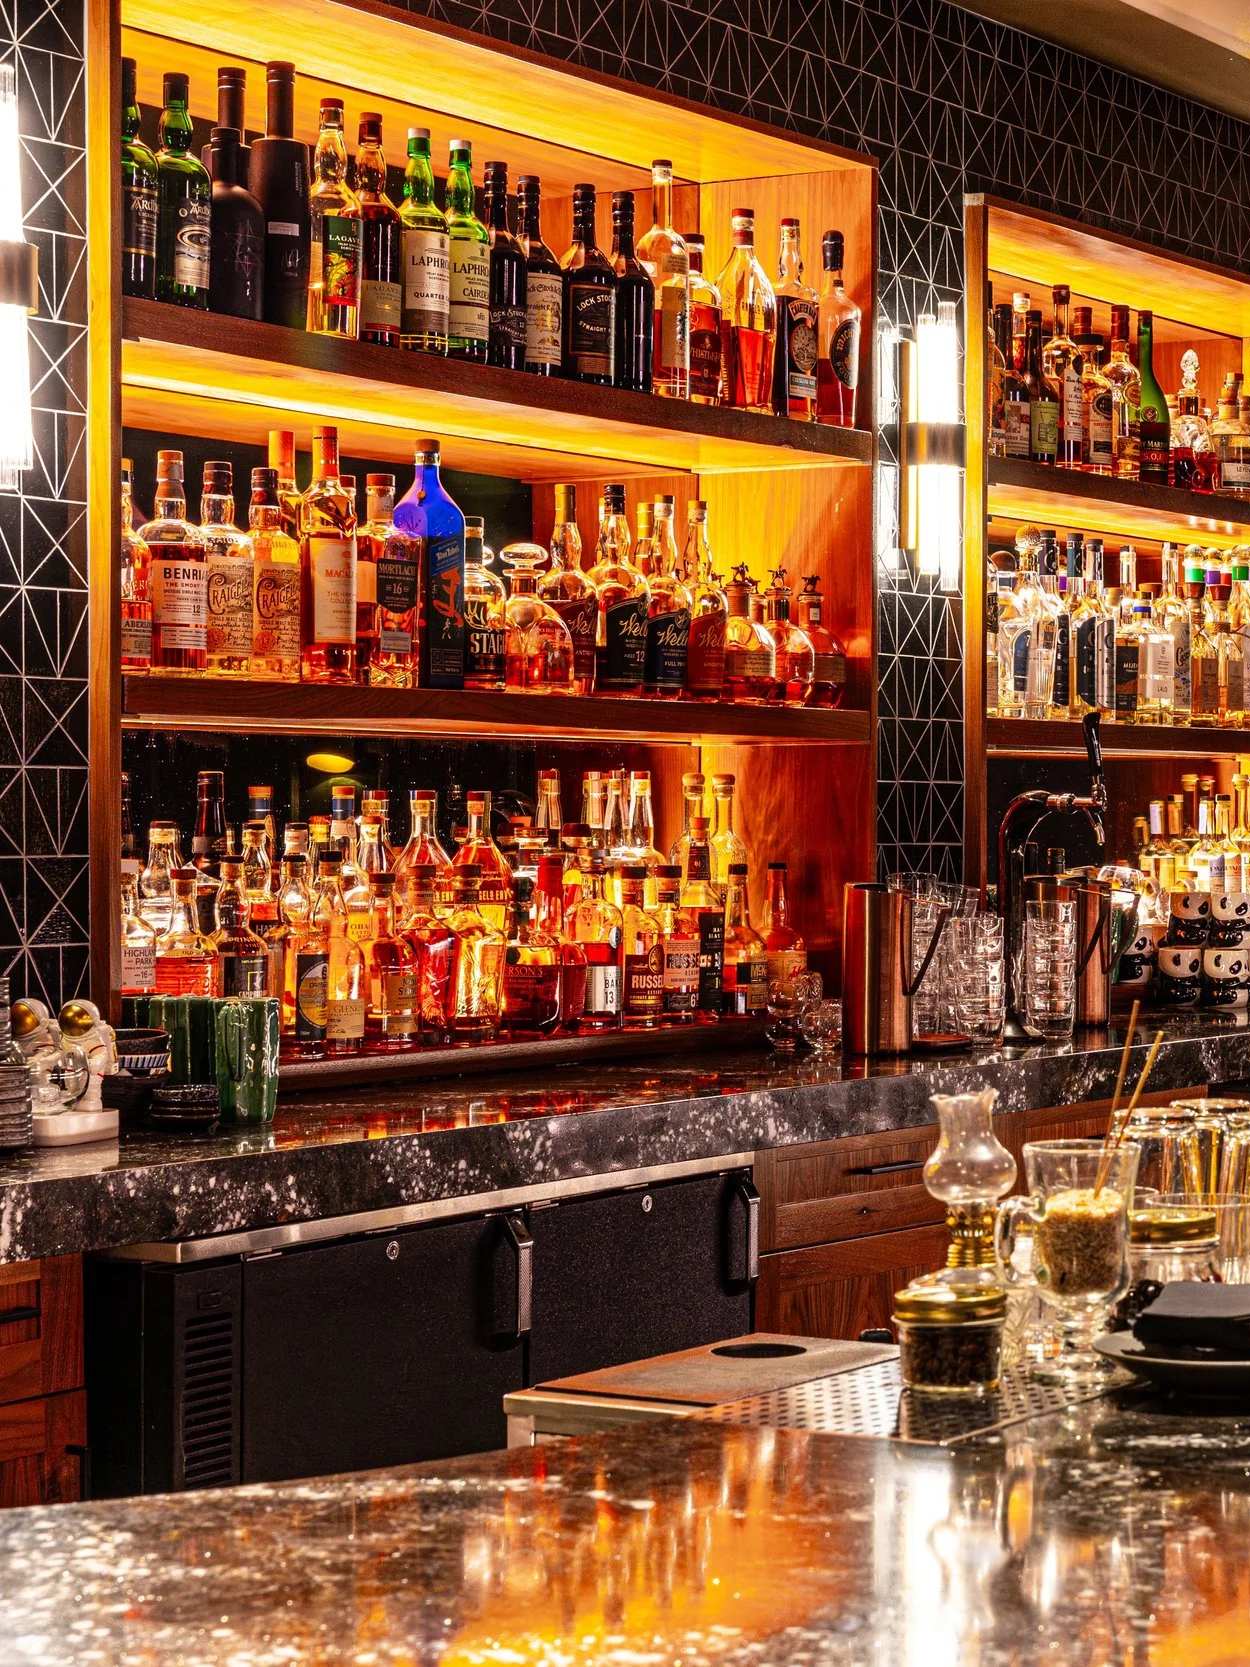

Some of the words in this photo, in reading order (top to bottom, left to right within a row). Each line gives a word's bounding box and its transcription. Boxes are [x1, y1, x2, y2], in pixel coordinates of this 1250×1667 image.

[413, 291, 445, 300] QUARTER
[576, 296, 595, 312] LOCK
[579, 320, 607, 333] STRAIGHT
[378, 563, 416, 576] MORTLACH
[393, 583, 402, 594] 16
[193, 604, 201, 613] 12
[635, 650, 645, 662] 12
[135, 957, 153, 965] PARK
[140, 970, 148, 979] 16
[604, 991, 614, 1004] 13
[690, 993, 696, 1008] 6
